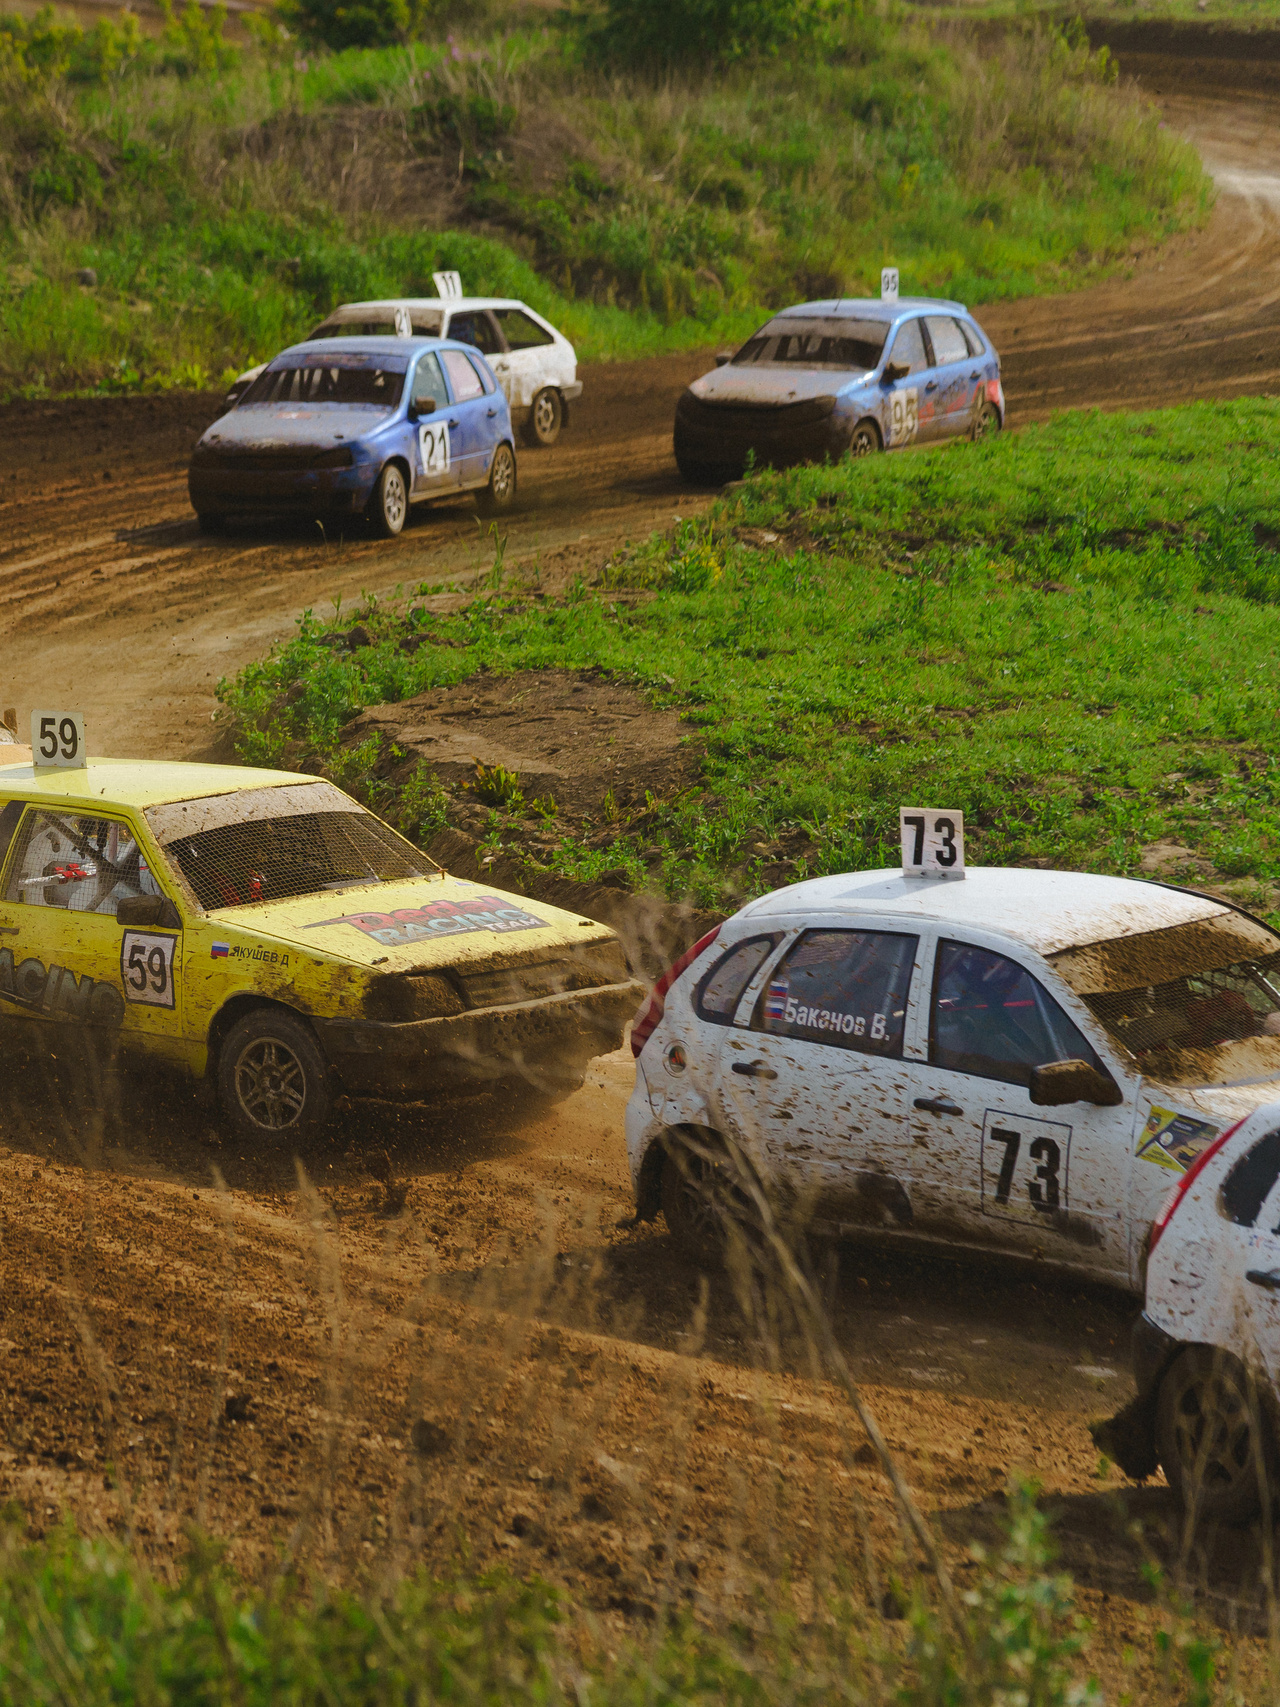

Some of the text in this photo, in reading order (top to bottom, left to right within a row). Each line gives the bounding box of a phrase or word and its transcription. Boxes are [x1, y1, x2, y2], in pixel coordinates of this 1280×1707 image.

[882, 273, 898, 292] 95
[893, 400, 916, 436] 95
[423, 426, 448, 471] 21
[40, 717, 79, 760] 59
[904, 816, 957, 867] 73
[312, 896, 512, 932] Dedal
[371, 909, 529, 944] RACING
[483, 918, 541, 932] TEAM
[128, 945, 167, 994] 59
[233, 946, 290, 967] ЯКУШЕВ Д
[784, 997, 890, 1041] Баканов В.
[990, 1127, 1061, 1213] 73
